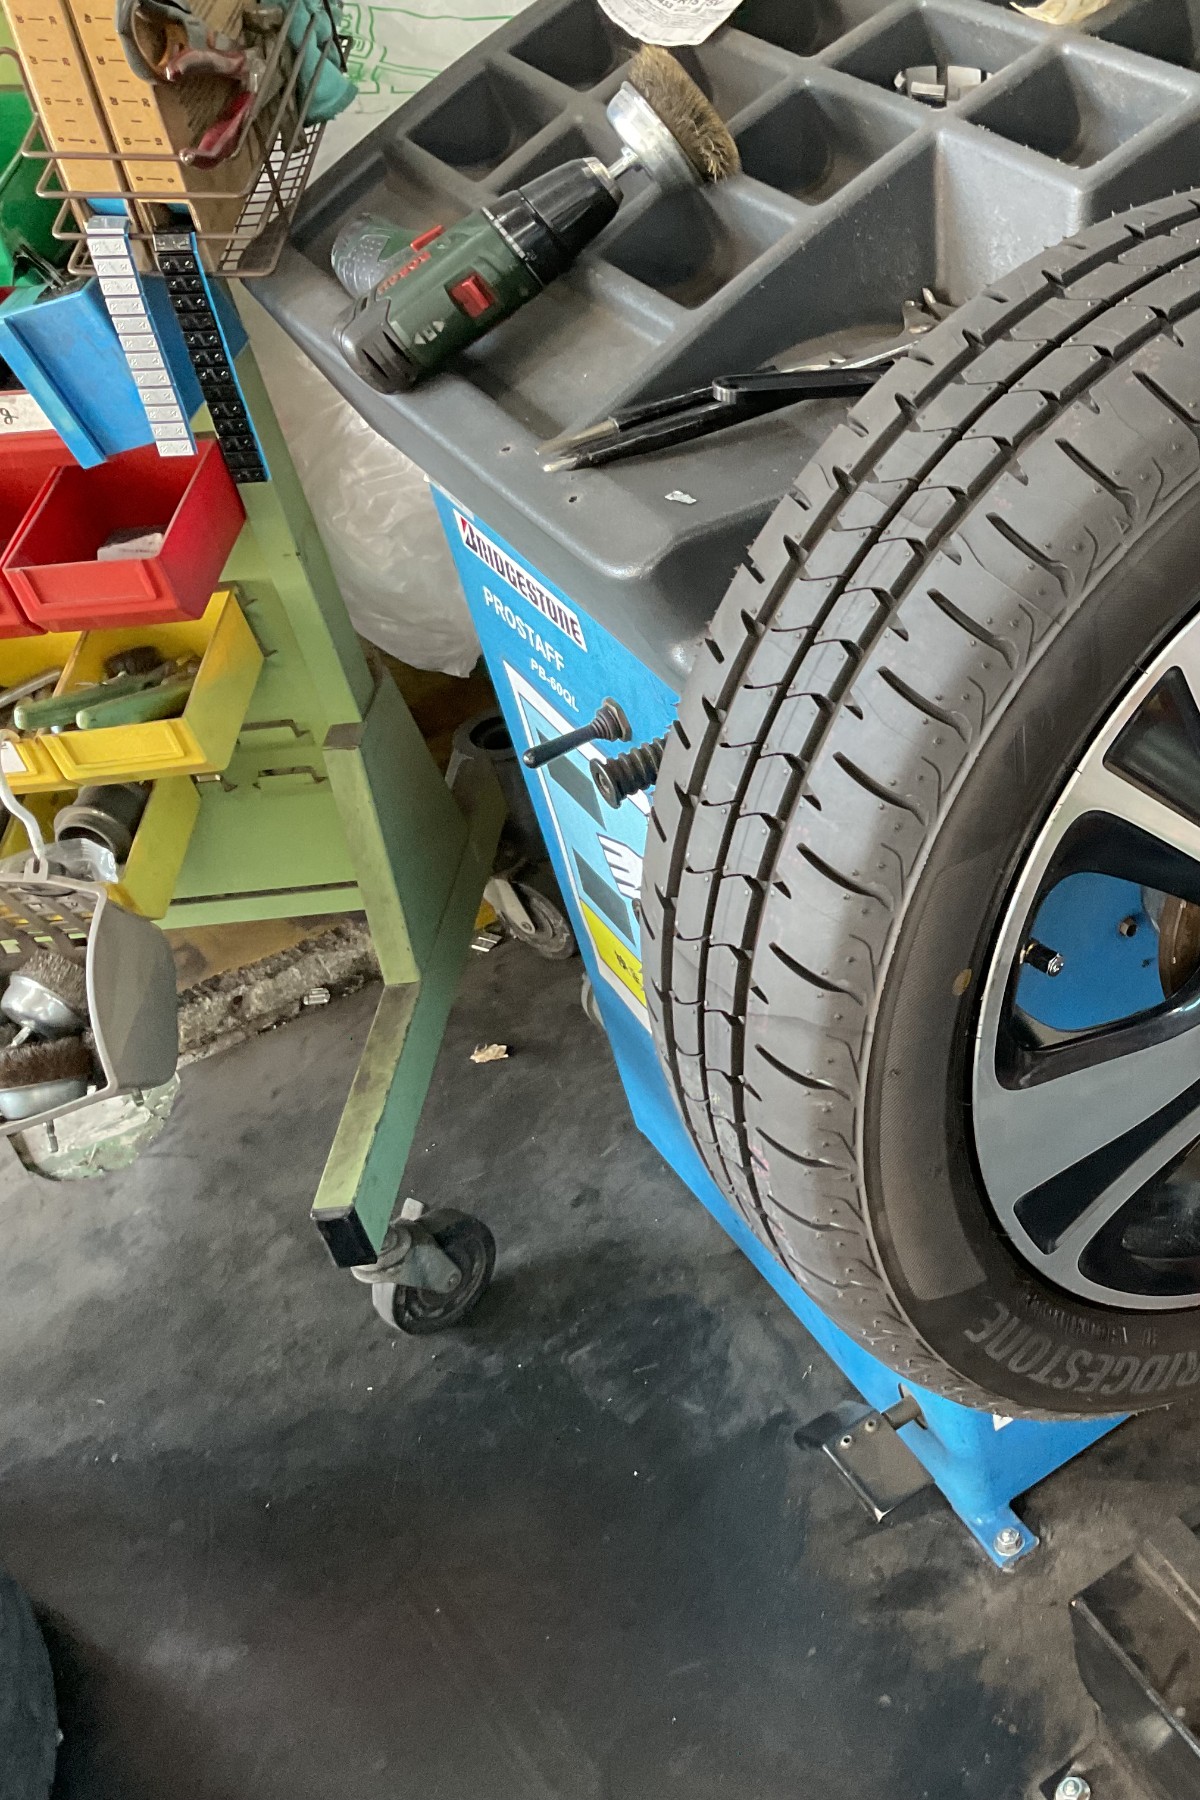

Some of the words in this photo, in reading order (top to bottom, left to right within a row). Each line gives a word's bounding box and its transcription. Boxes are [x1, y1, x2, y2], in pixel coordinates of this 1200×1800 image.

[460, 516, 584, 646] BRIDGESTONE
[482, 585, 565, 672] PROSTAFF
[530, 657, 579, 712] PB-60QL
